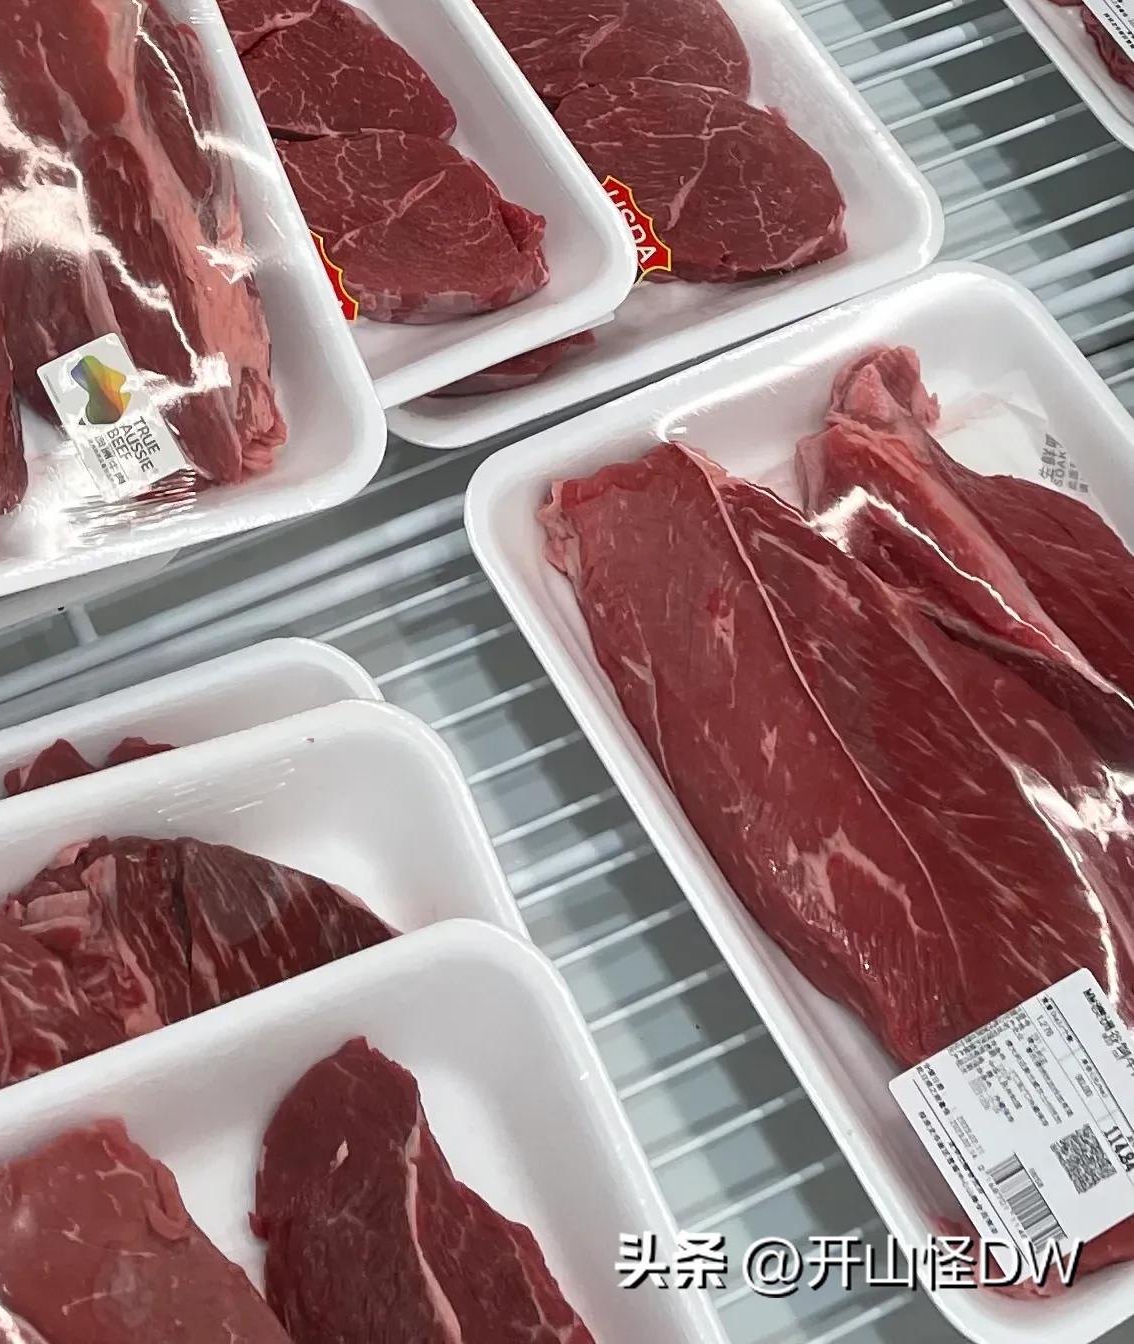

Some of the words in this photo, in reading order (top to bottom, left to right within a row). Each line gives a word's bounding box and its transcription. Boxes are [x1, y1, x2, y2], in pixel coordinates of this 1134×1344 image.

[105, 426, 134, 463] BEEF
[117, 420, 155, 473] AUSSIE
[130, 414, 161, 455] TRUE
[1102, 1124, 1134, 1173] 114.84
